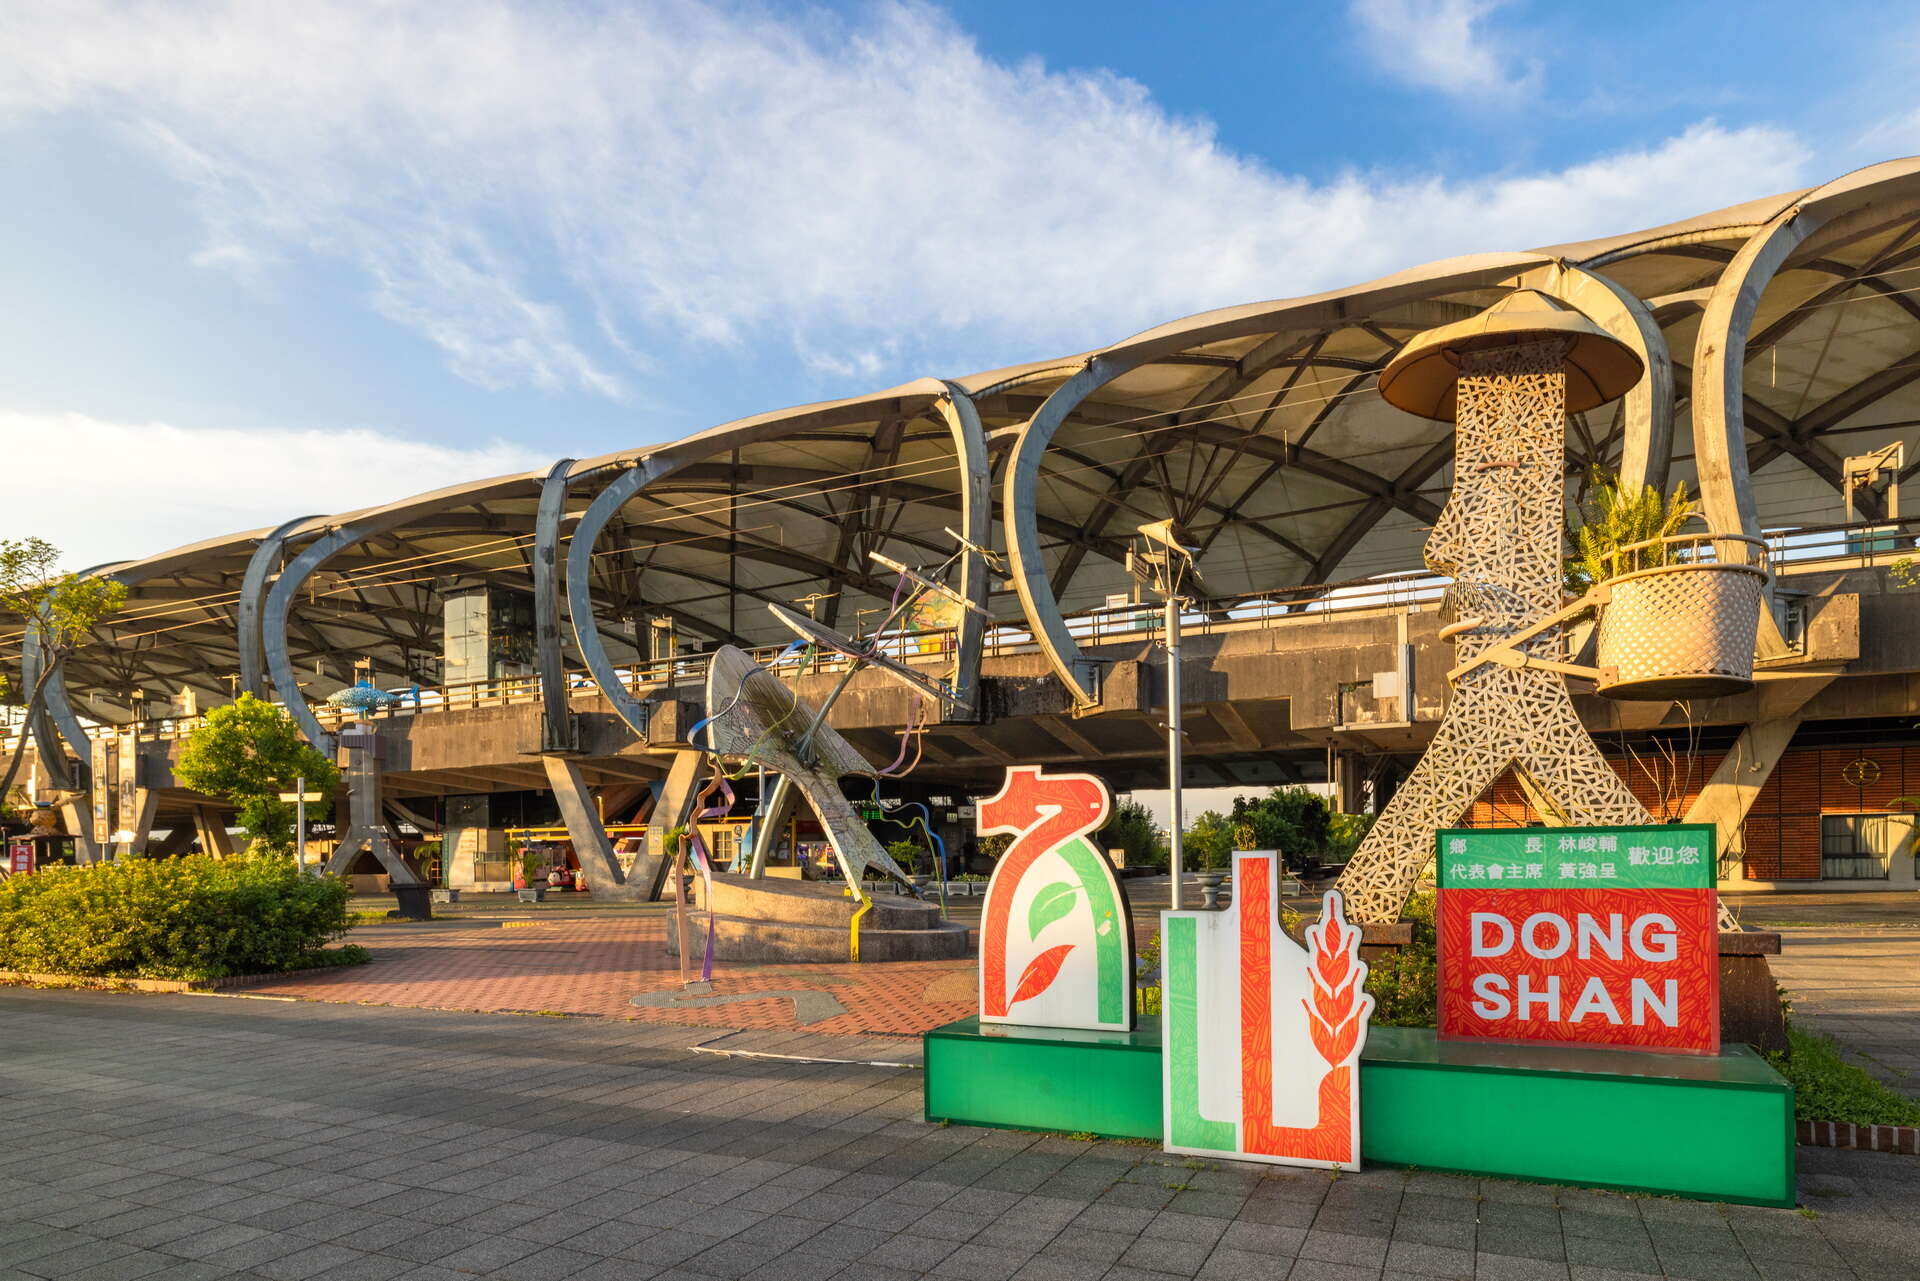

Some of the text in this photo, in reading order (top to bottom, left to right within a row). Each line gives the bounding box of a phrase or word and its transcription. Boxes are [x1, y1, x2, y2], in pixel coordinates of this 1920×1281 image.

[1450, 863, 1543, 880] 代表會主席
[1628, 846, 1700, 865] 歡迎您
[1471, 912, 1678, 962] DONG
[1472, 973, 1678, 1027] SHAN
